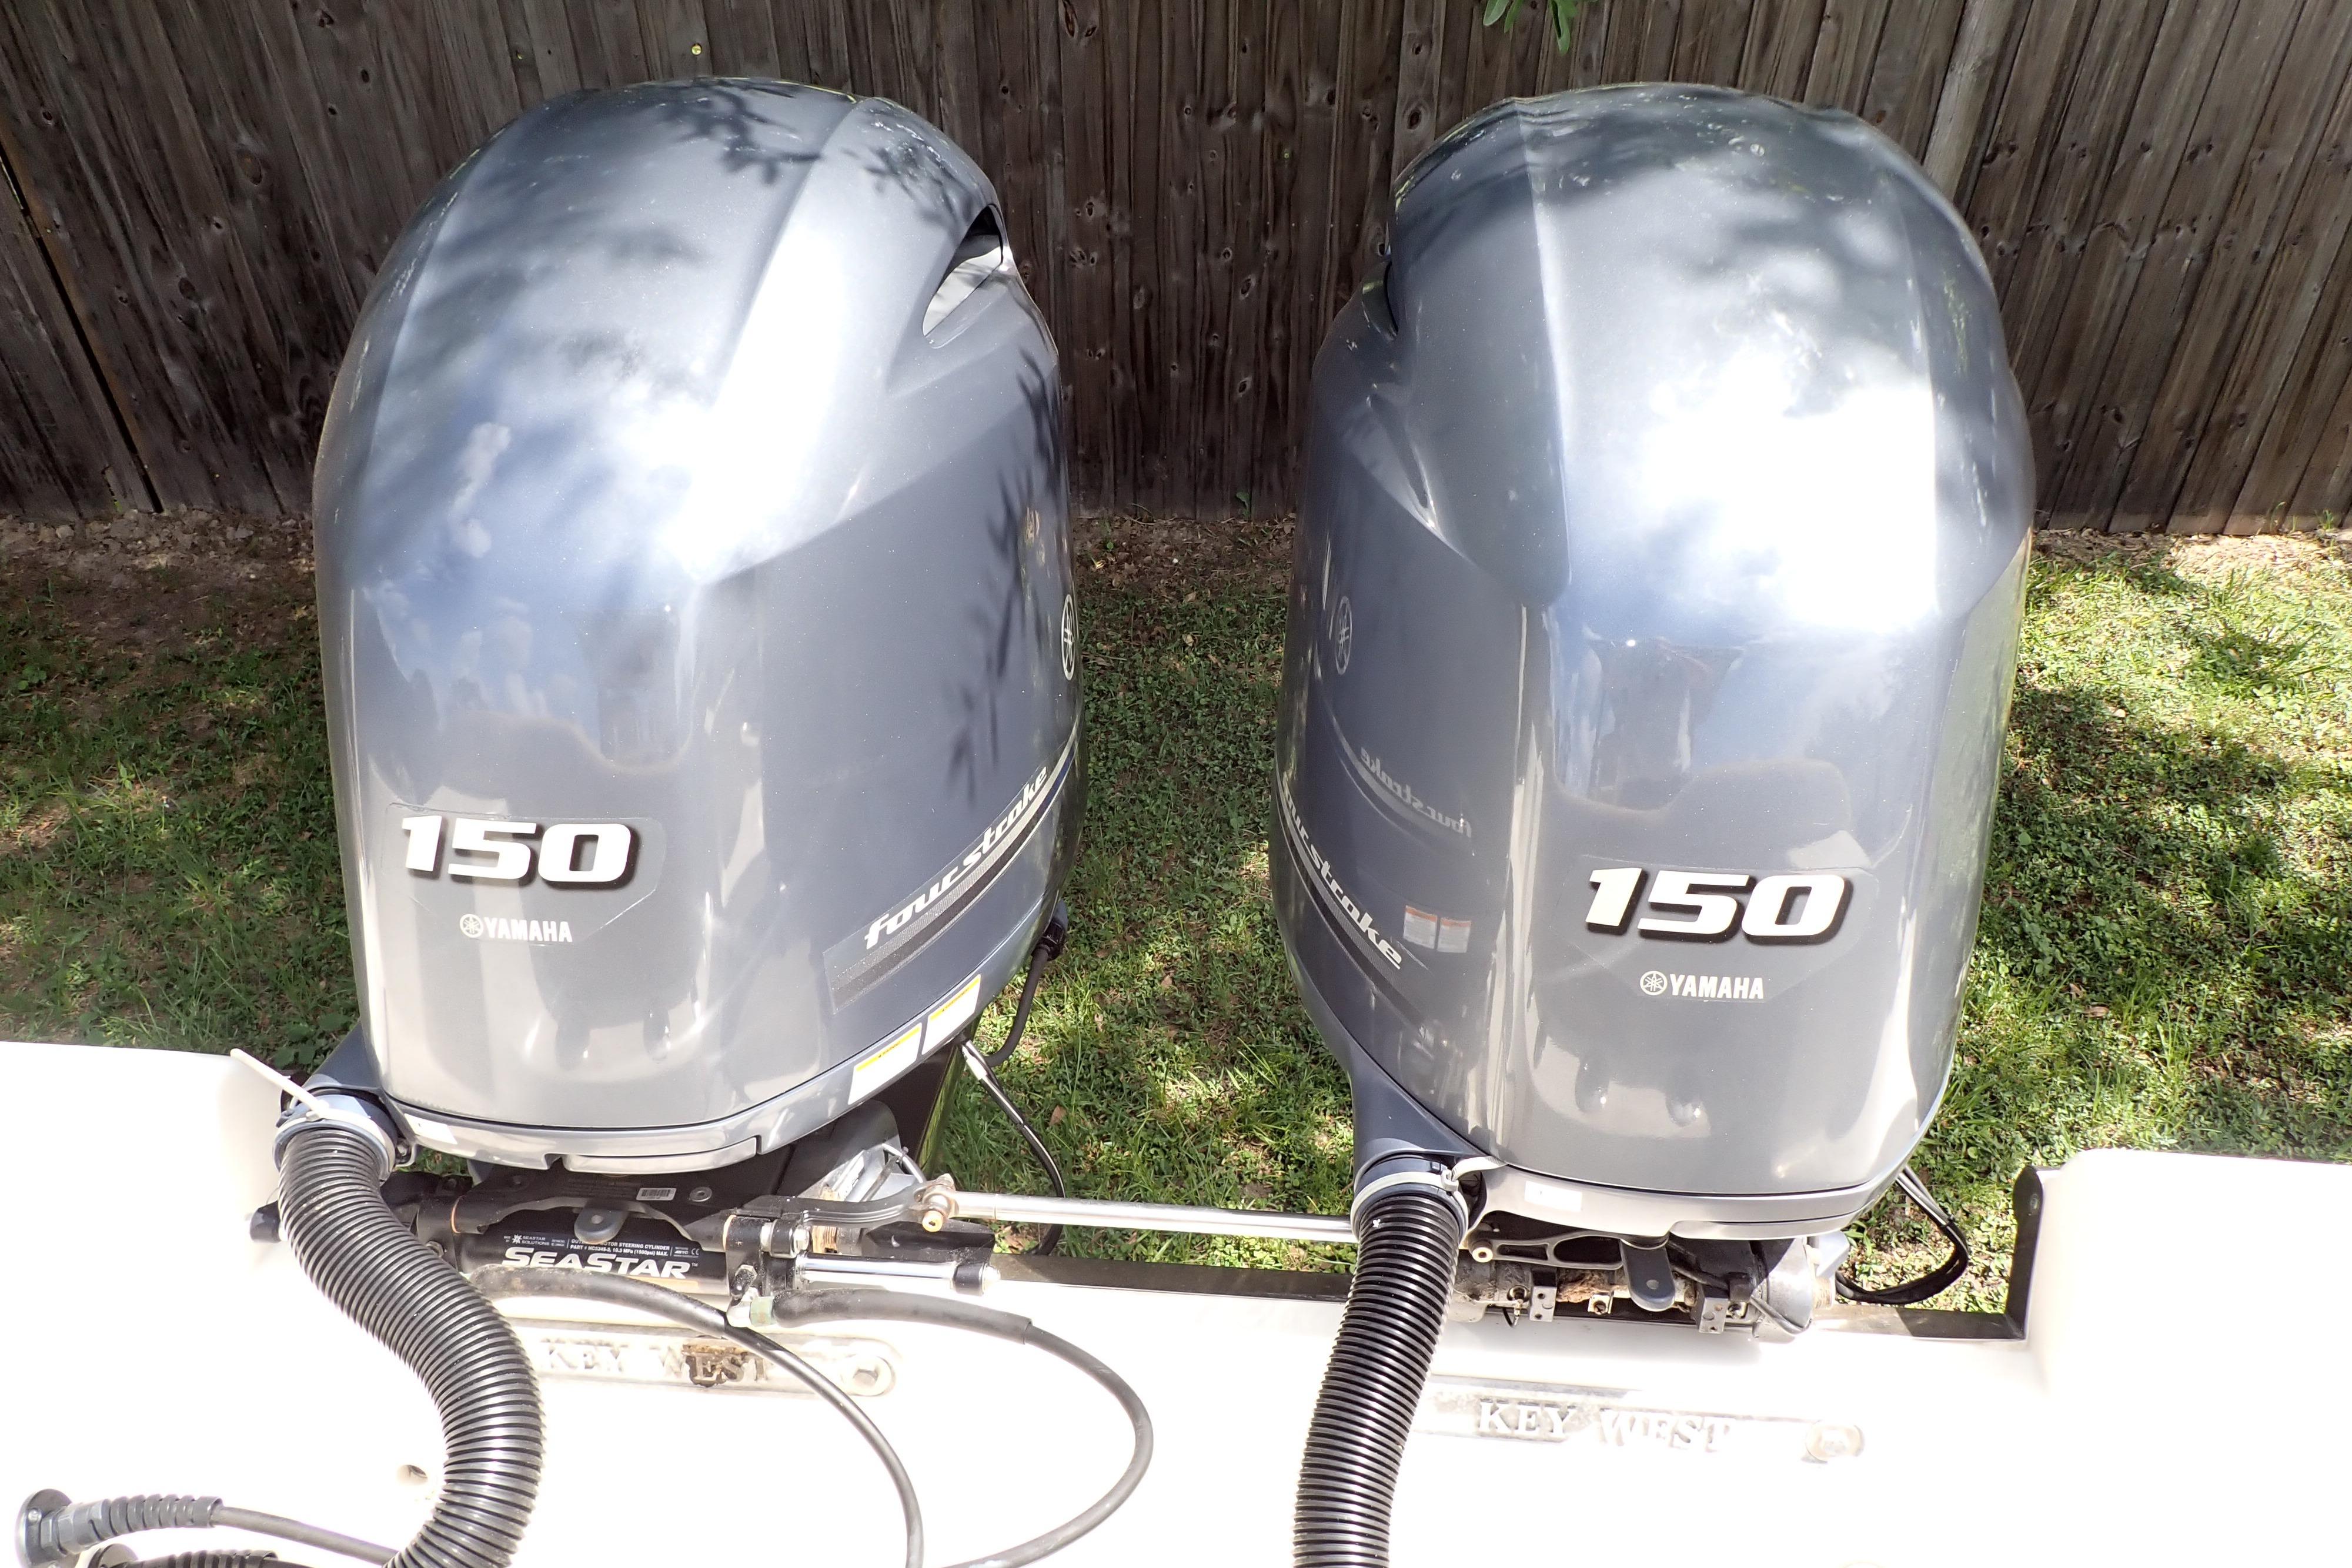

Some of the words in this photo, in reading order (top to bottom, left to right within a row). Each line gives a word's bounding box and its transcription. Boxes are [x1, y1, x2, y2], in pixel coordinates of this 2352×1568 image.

[402, 815, 639, 889] 150
[484, 917, 573, 942] YAMAHA
[1585, 867, 1852, 944] 150
[1669, 974, 1764, 999] YAMAHA
[1479, 1402, 1576, 1435] KEY
[1599, 1409, 1733, 1450] WEST
